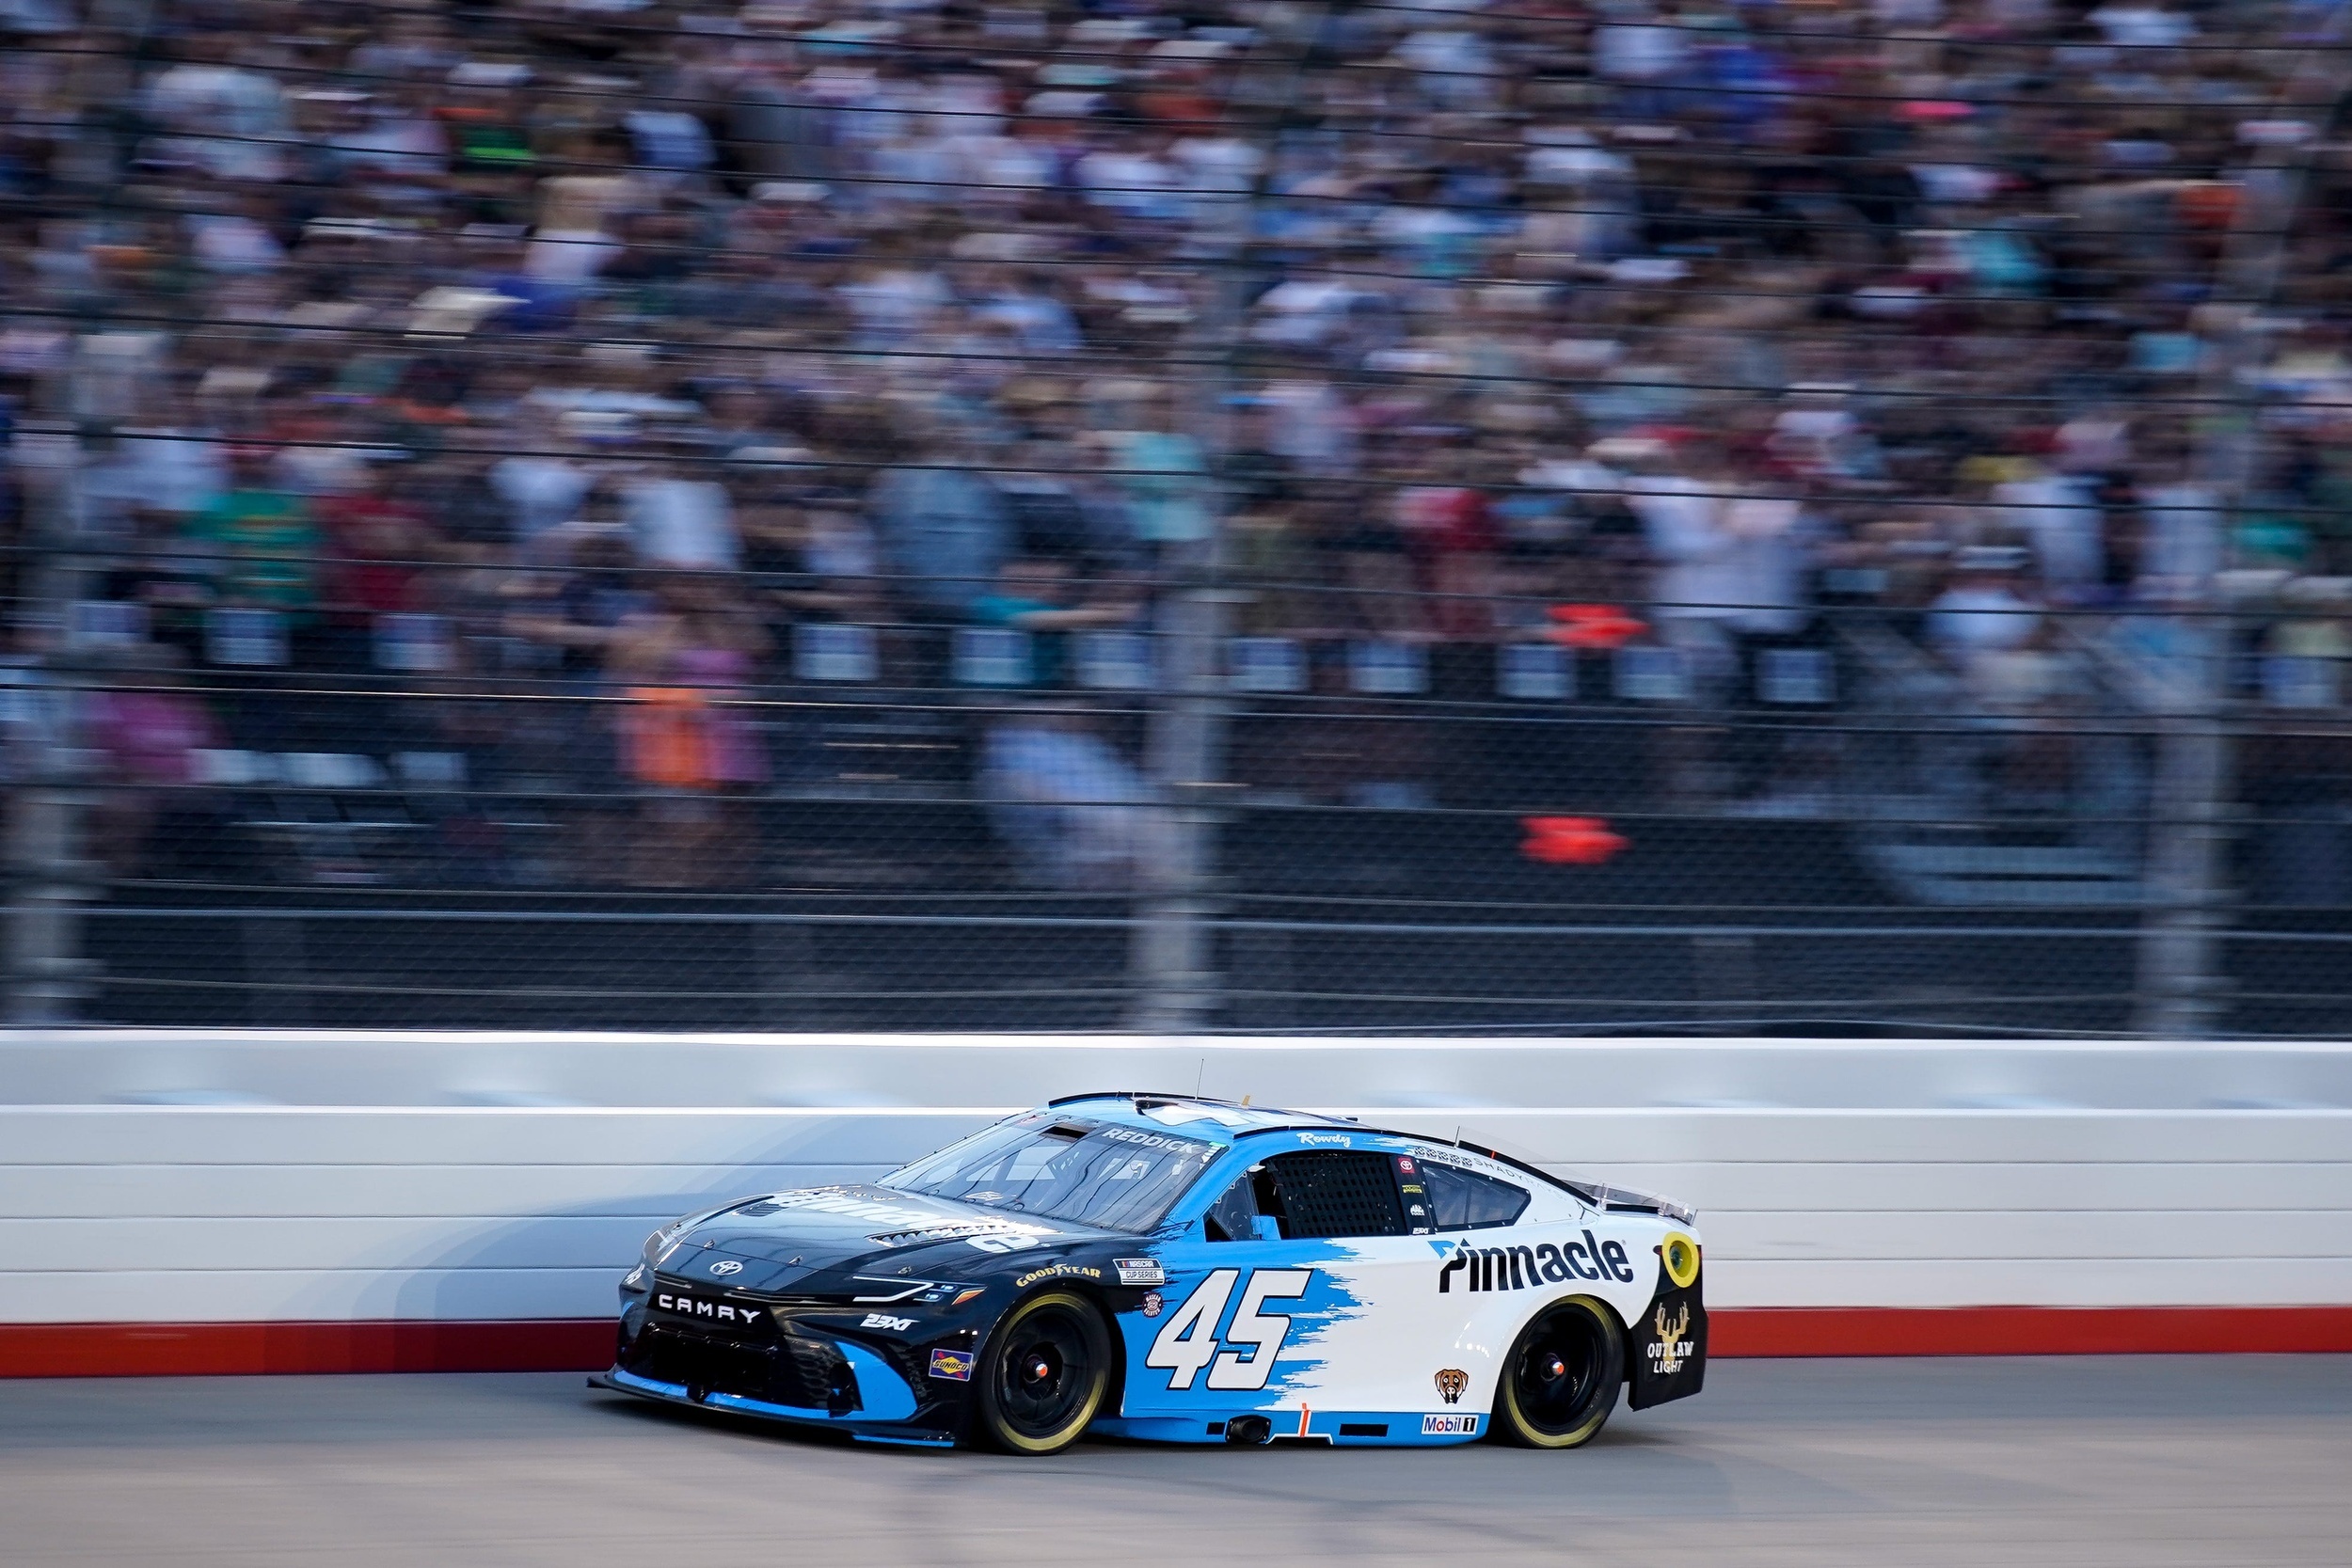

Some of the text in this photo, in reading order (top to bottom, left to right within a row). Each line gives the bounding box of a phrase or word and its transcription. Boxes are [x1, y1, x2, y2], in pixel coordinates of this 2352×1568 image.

[1102, 1128, 1200, 1154] REDDICK
[1295, 1132, 1352, 1148] Rowdy
[1427, 1229, 1634, 1294] Pinnacle
[1016, 1263, 1101, 1287] GOODYEAR
[659, 1293, 761, 1323] CAMRY
[1146, 1267, 1313, 1390] 45
[1647, 1341, 1694, 1358] OUTLAW
[933, 1360, 969, 1371] SUNOCO
[1653, 1360, 1683, 1374] LIGHT
[1423, 1417, 1462, 1433] Mobil
